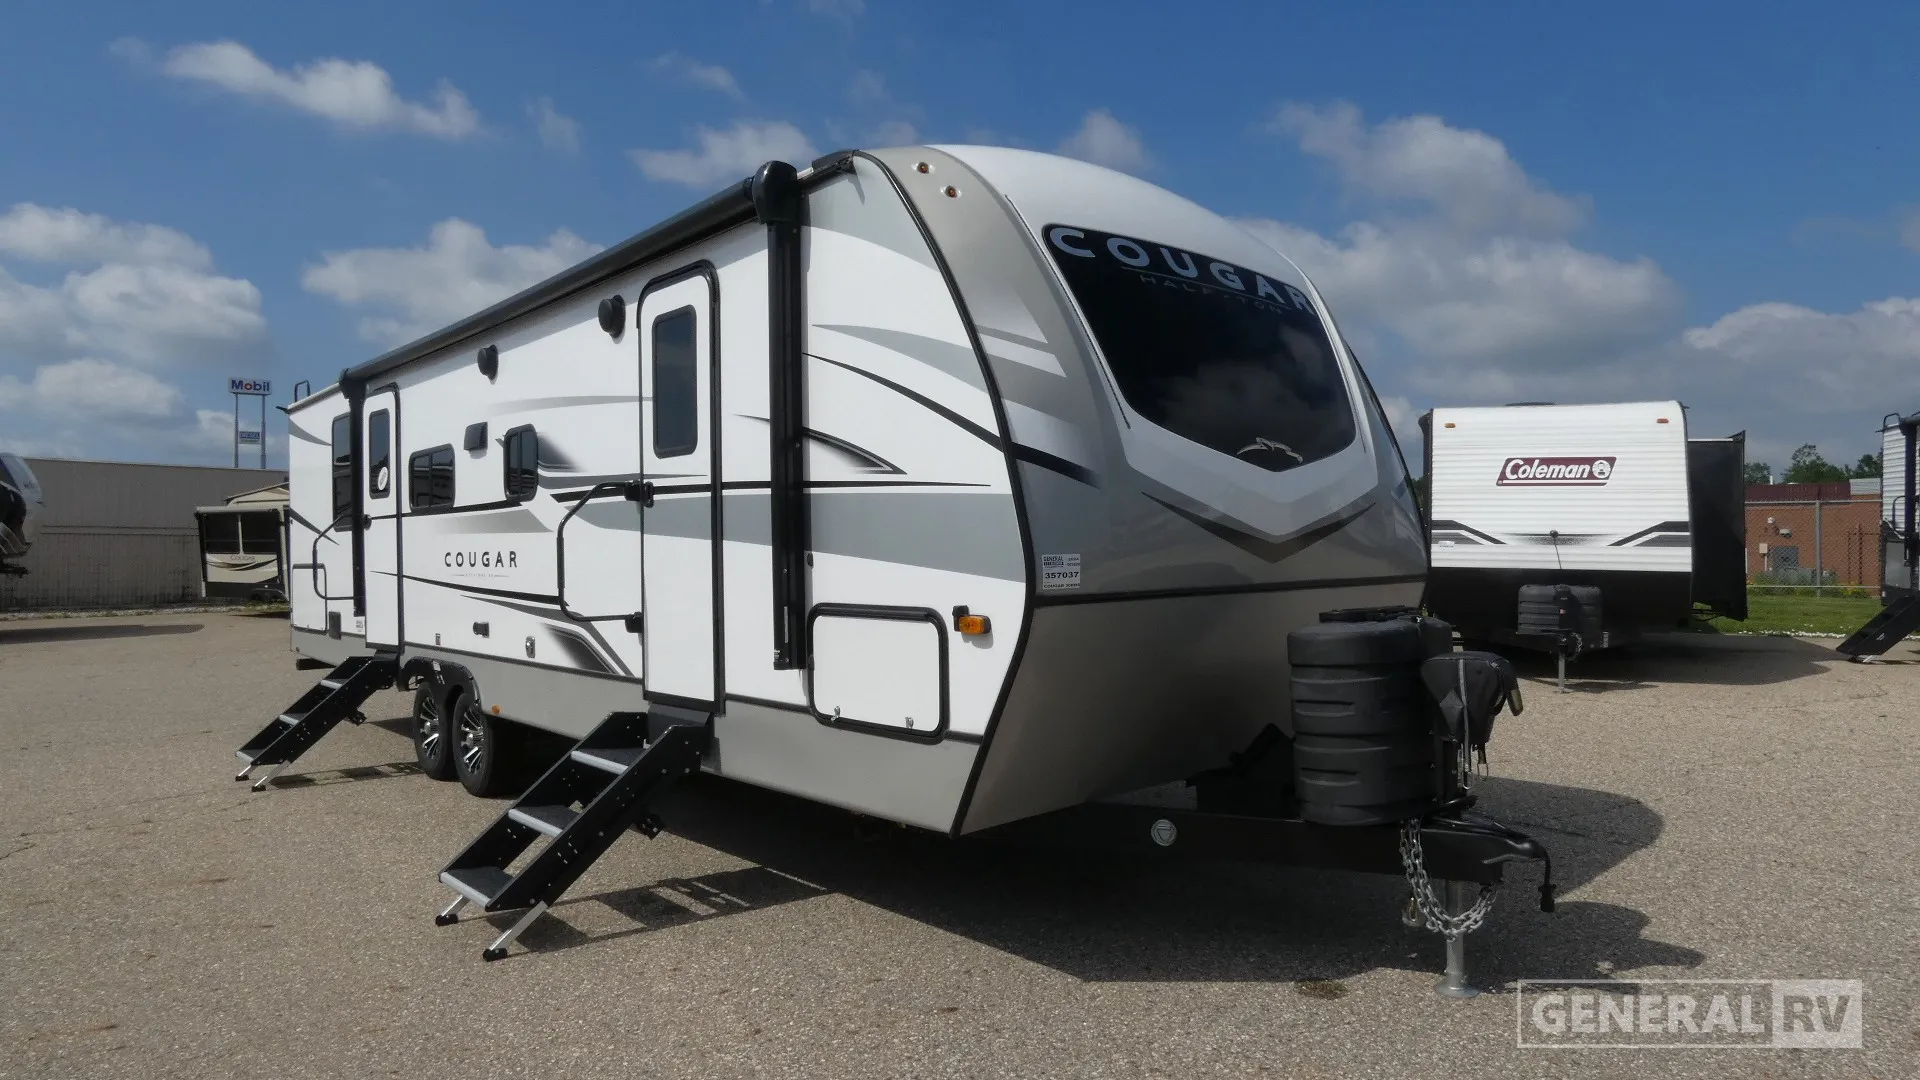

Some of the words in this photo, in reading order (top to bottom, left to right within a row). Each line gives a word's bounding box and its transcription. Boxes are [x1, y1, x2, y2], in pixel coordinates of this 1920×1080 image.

[1049, 227, 1315, 316] COUGAR
[231, 379, 270, 391] Mobil
[1505, 459, 1591, 480] Coleman
[444, 550, 518, 568] COUGAR
[1044, 571, 1080, 579] 357037
